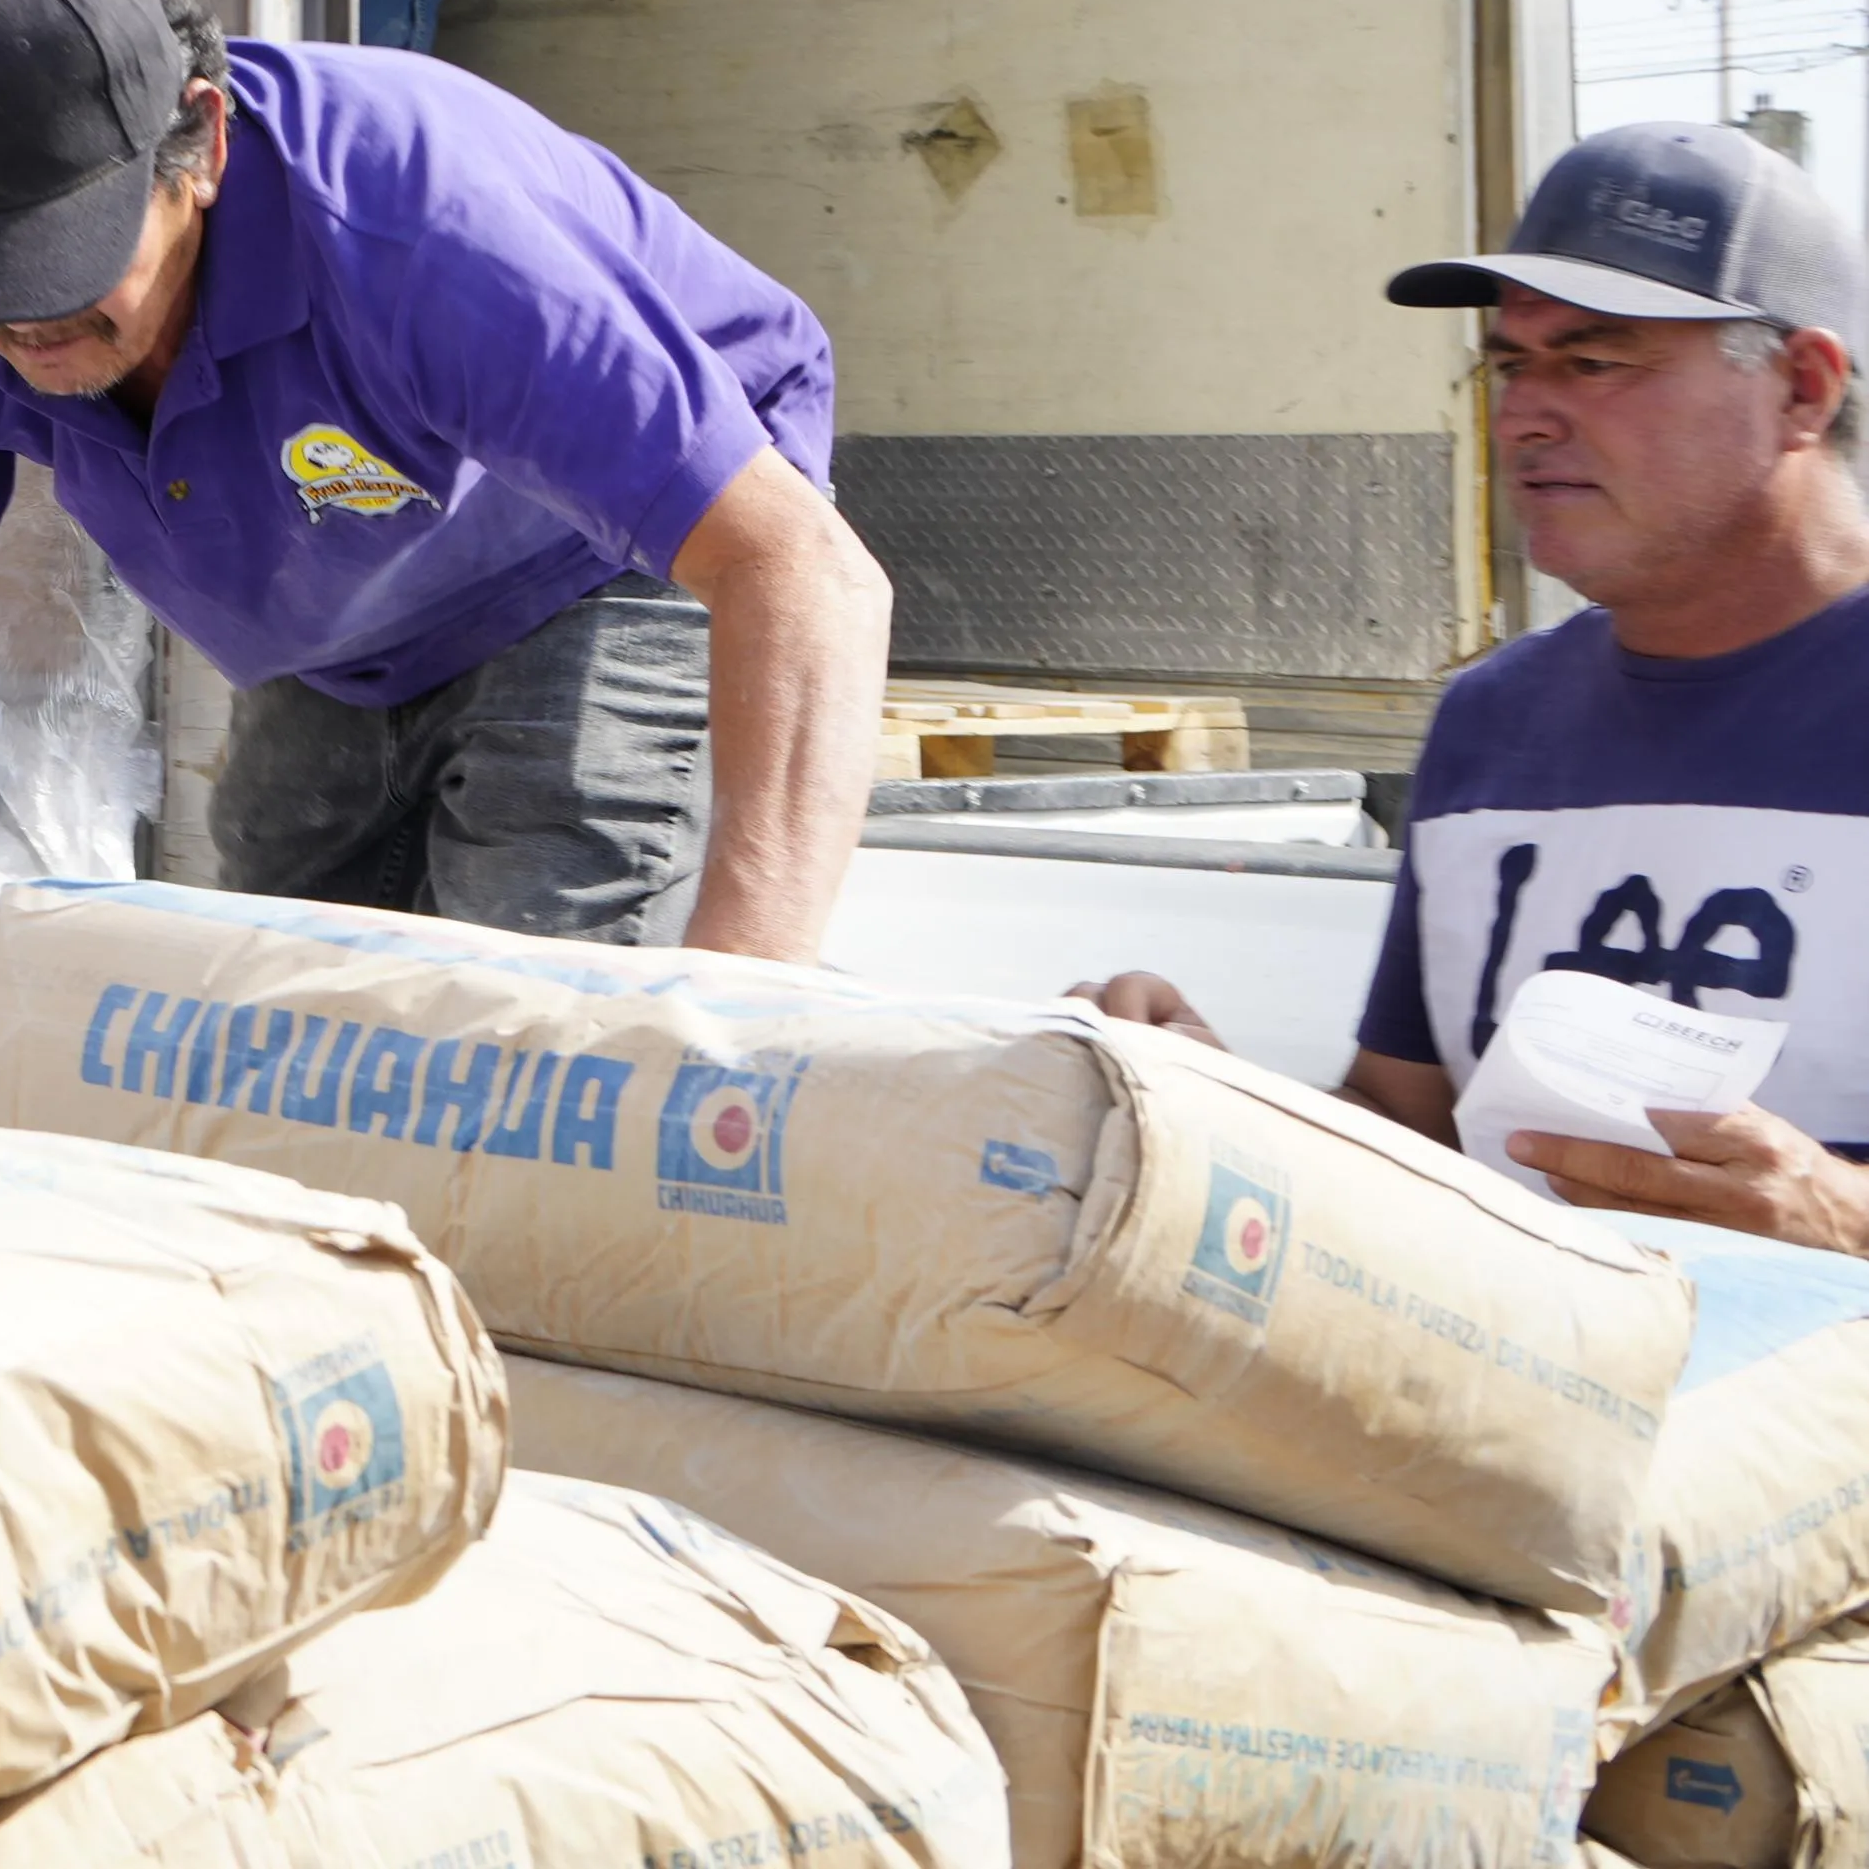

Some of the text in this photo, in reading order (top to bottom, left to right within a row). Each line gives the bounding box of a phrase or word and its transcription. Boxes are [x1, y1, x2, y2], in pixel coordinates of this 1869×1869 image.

[81, 983, 635, 1171] CHIHUAHUA
[656, 1183, 789, 1226] CHIHUAHUA
[1300, 1240, 1364, 1304] TODA
[1366, 1280, 1401, 1319] LA
[1402, 1293, 1492, 1363] FUERZA
[1494, 1334, 1525, 1373] DE
[1525, 1344, 1624, 1421] NUESTRA
[1220, 1727, 1330, 1767] NUESTRA
[1334, 1738, 1366, 1771] DE
